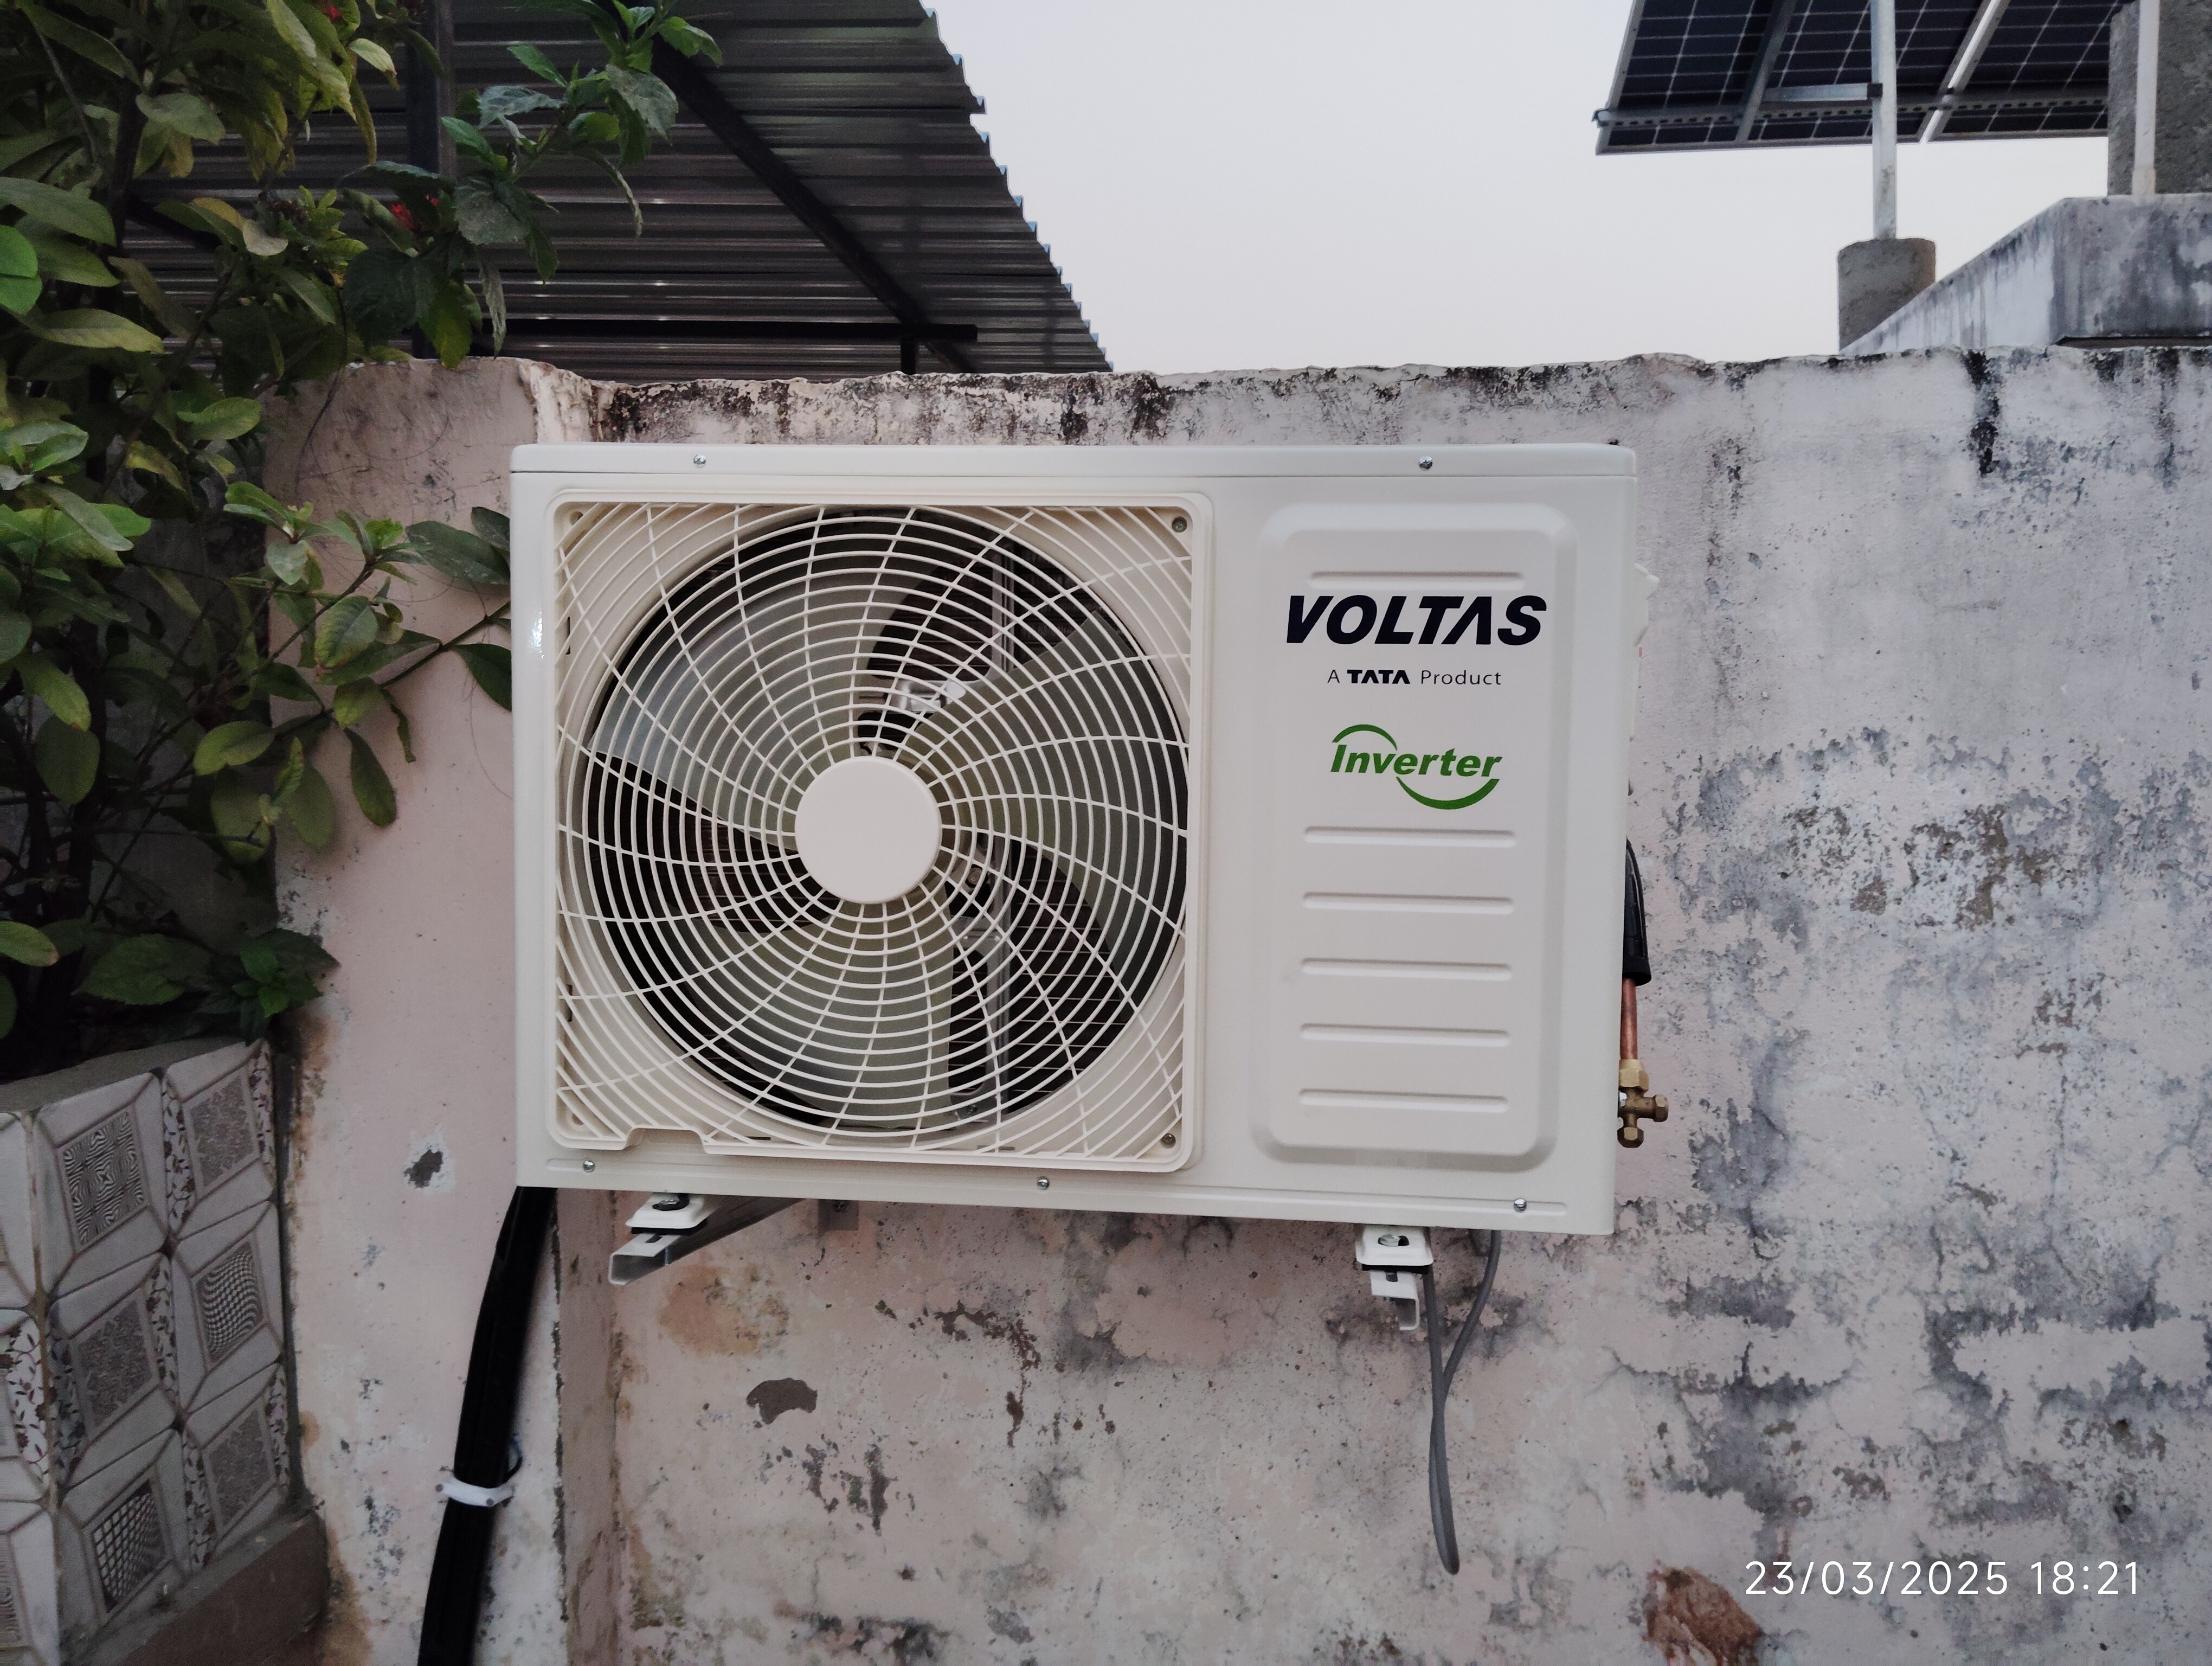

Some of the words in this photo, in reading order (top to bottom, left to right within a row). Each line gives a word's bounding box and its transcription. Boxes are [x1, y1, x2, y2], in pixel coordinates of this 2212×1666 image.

[1286, 594, 1547, 646] VOLTAS
[1327, 669, 1341, 684] A
[1346, 669, 1411, 684] TATA
[1420, 669, 1502, 685] Product
[1330, 744, 1503, 778] Inverter
